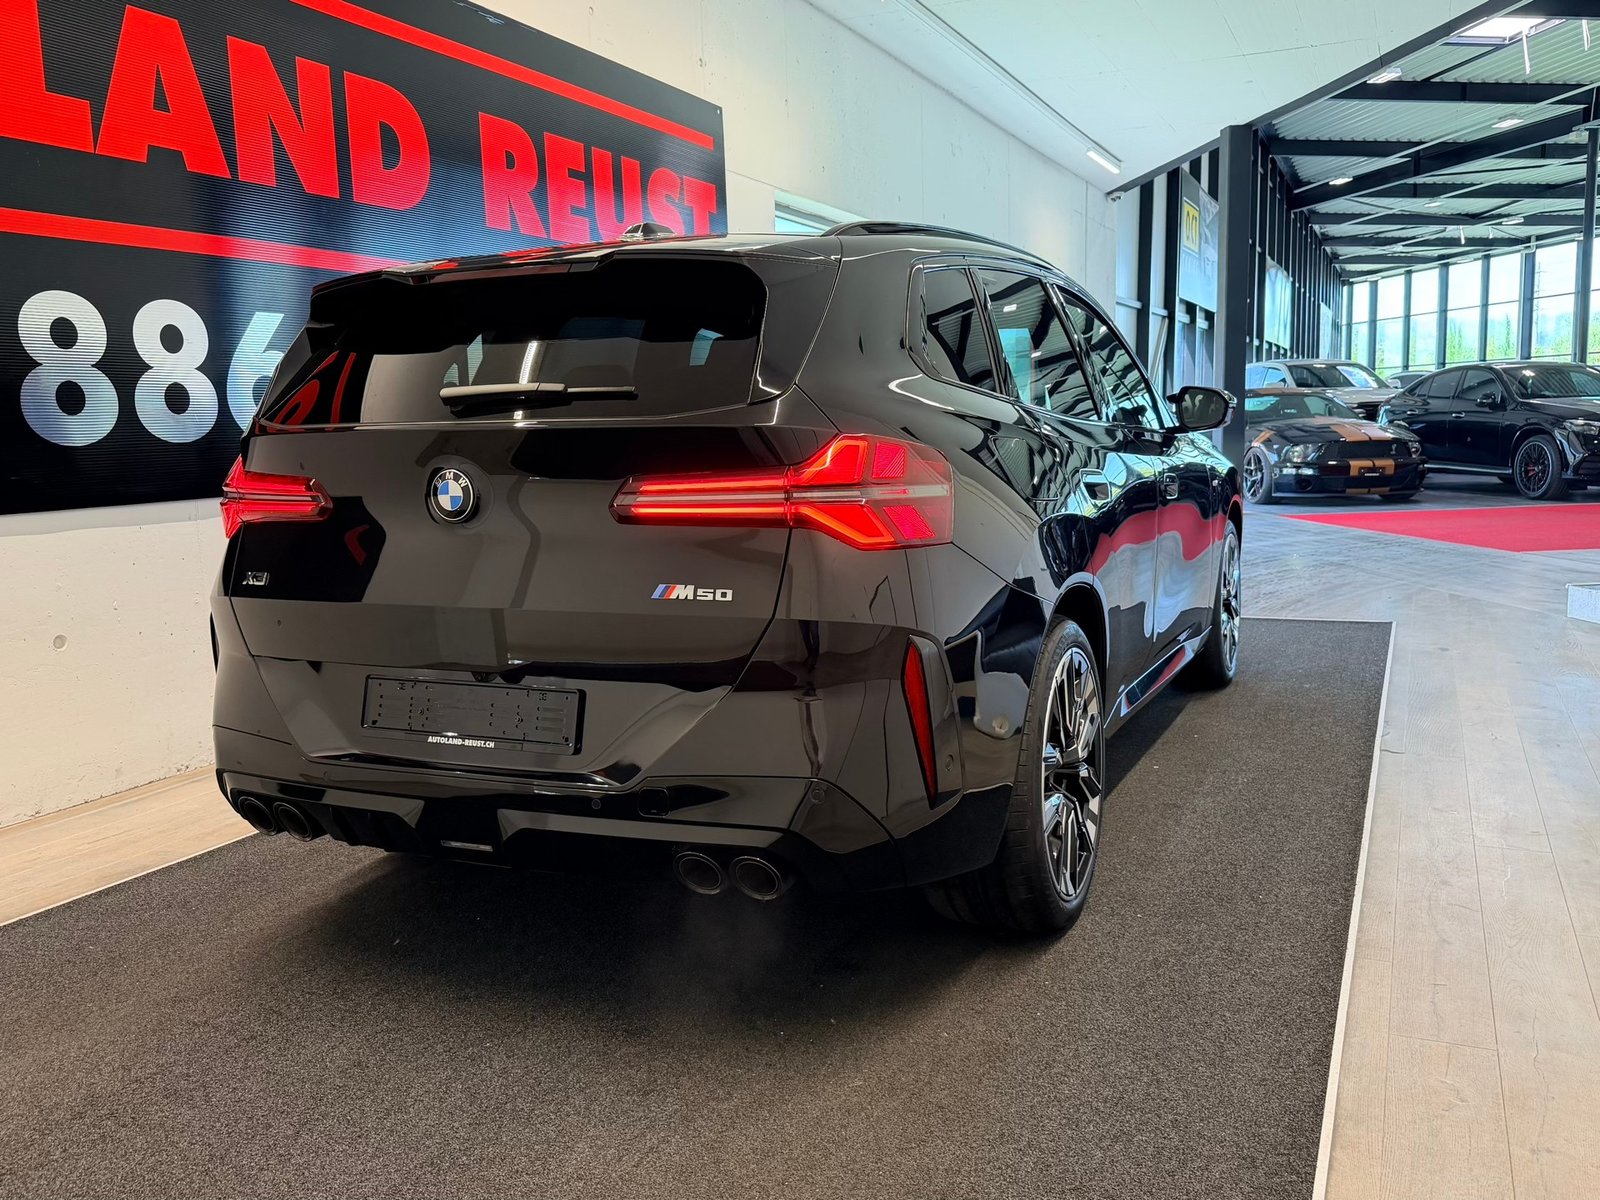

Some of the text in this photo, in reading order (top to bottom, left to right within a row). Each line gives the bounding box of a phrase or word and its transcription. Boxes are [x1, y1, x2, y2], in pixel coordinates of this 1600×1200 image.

[0, 0, 717, 244] LAND REUST
[17, 290, 285, 447] 886
[434, 471, 468, 488] BMW
[242, 571, 270, 586] X3
[668, 584, 733, 601] M50
[427, 735, 495, 749] AUTOLAND-REUST.CH
